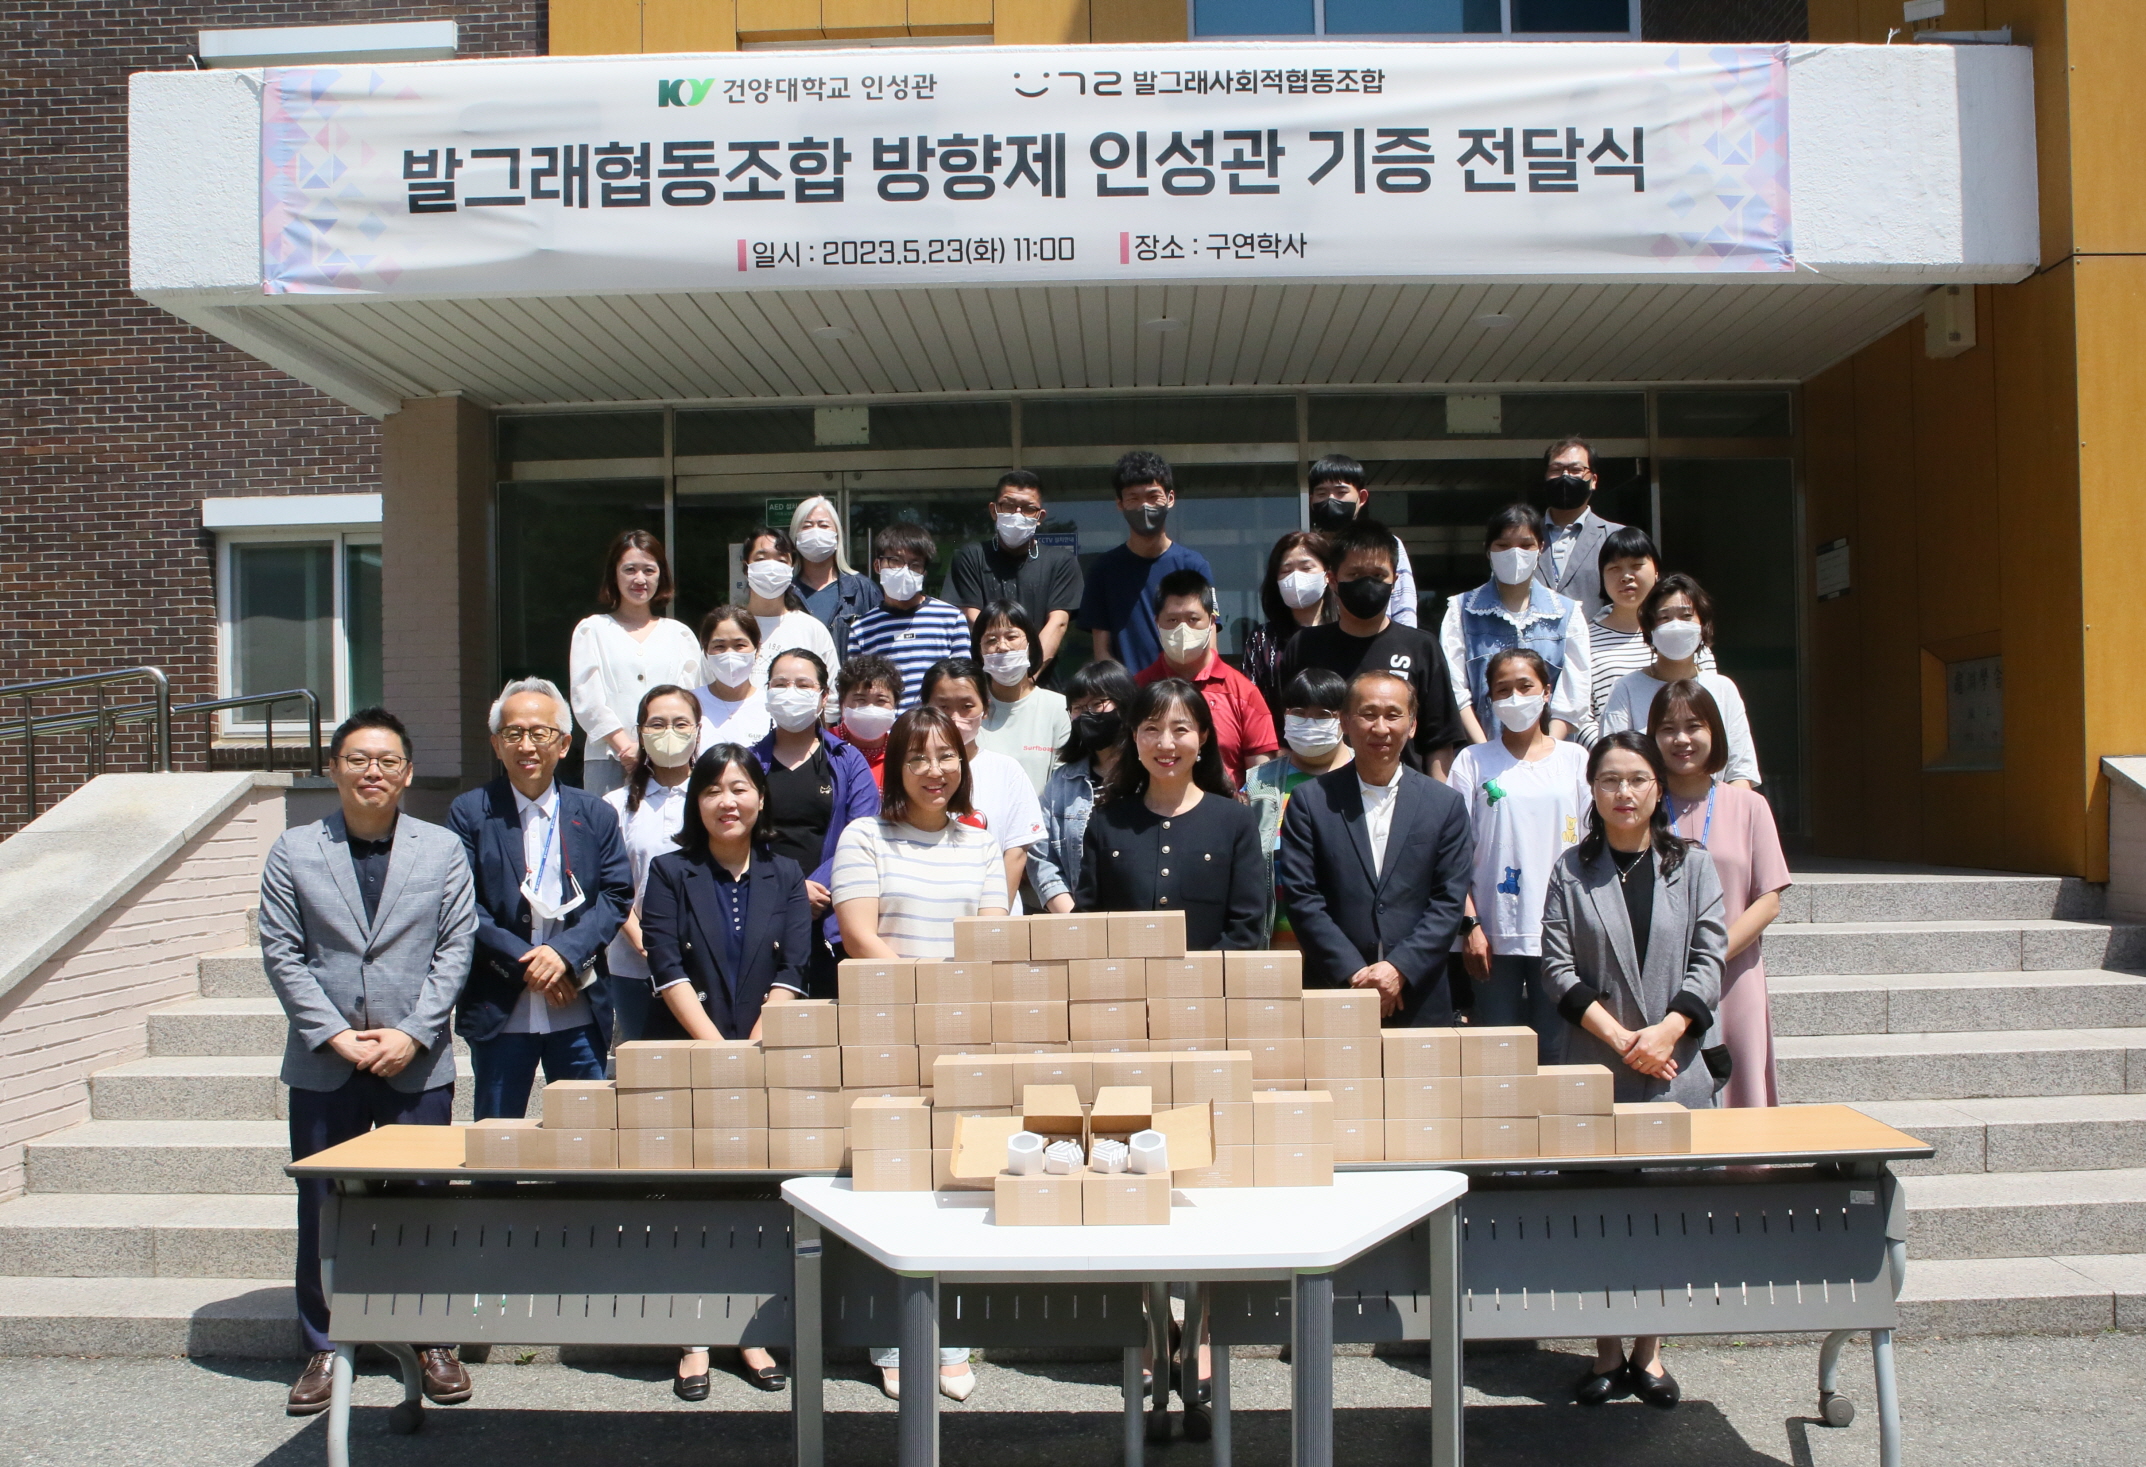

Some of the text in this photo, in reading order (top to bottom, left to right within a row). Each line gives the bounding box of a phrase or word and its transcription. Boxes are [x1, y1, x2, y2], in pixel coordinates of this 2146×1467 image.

[724, 77, 851, 104] 건양대학교
[861, 74, 938, 101] 인성관
[1133, 68, 1386, 96] 발그래사회적협동조합
[402, 126, 1645, 214] 발그래협동조합 방향제 인성관 기증 전달식
[823, 237, 1005, 266] 2023.5.23(화)
[1013, 236, 1075, 262] 11:00
[1205, 232, 1308, 260] 구연학사
[769, 503, 785, 511] AED
